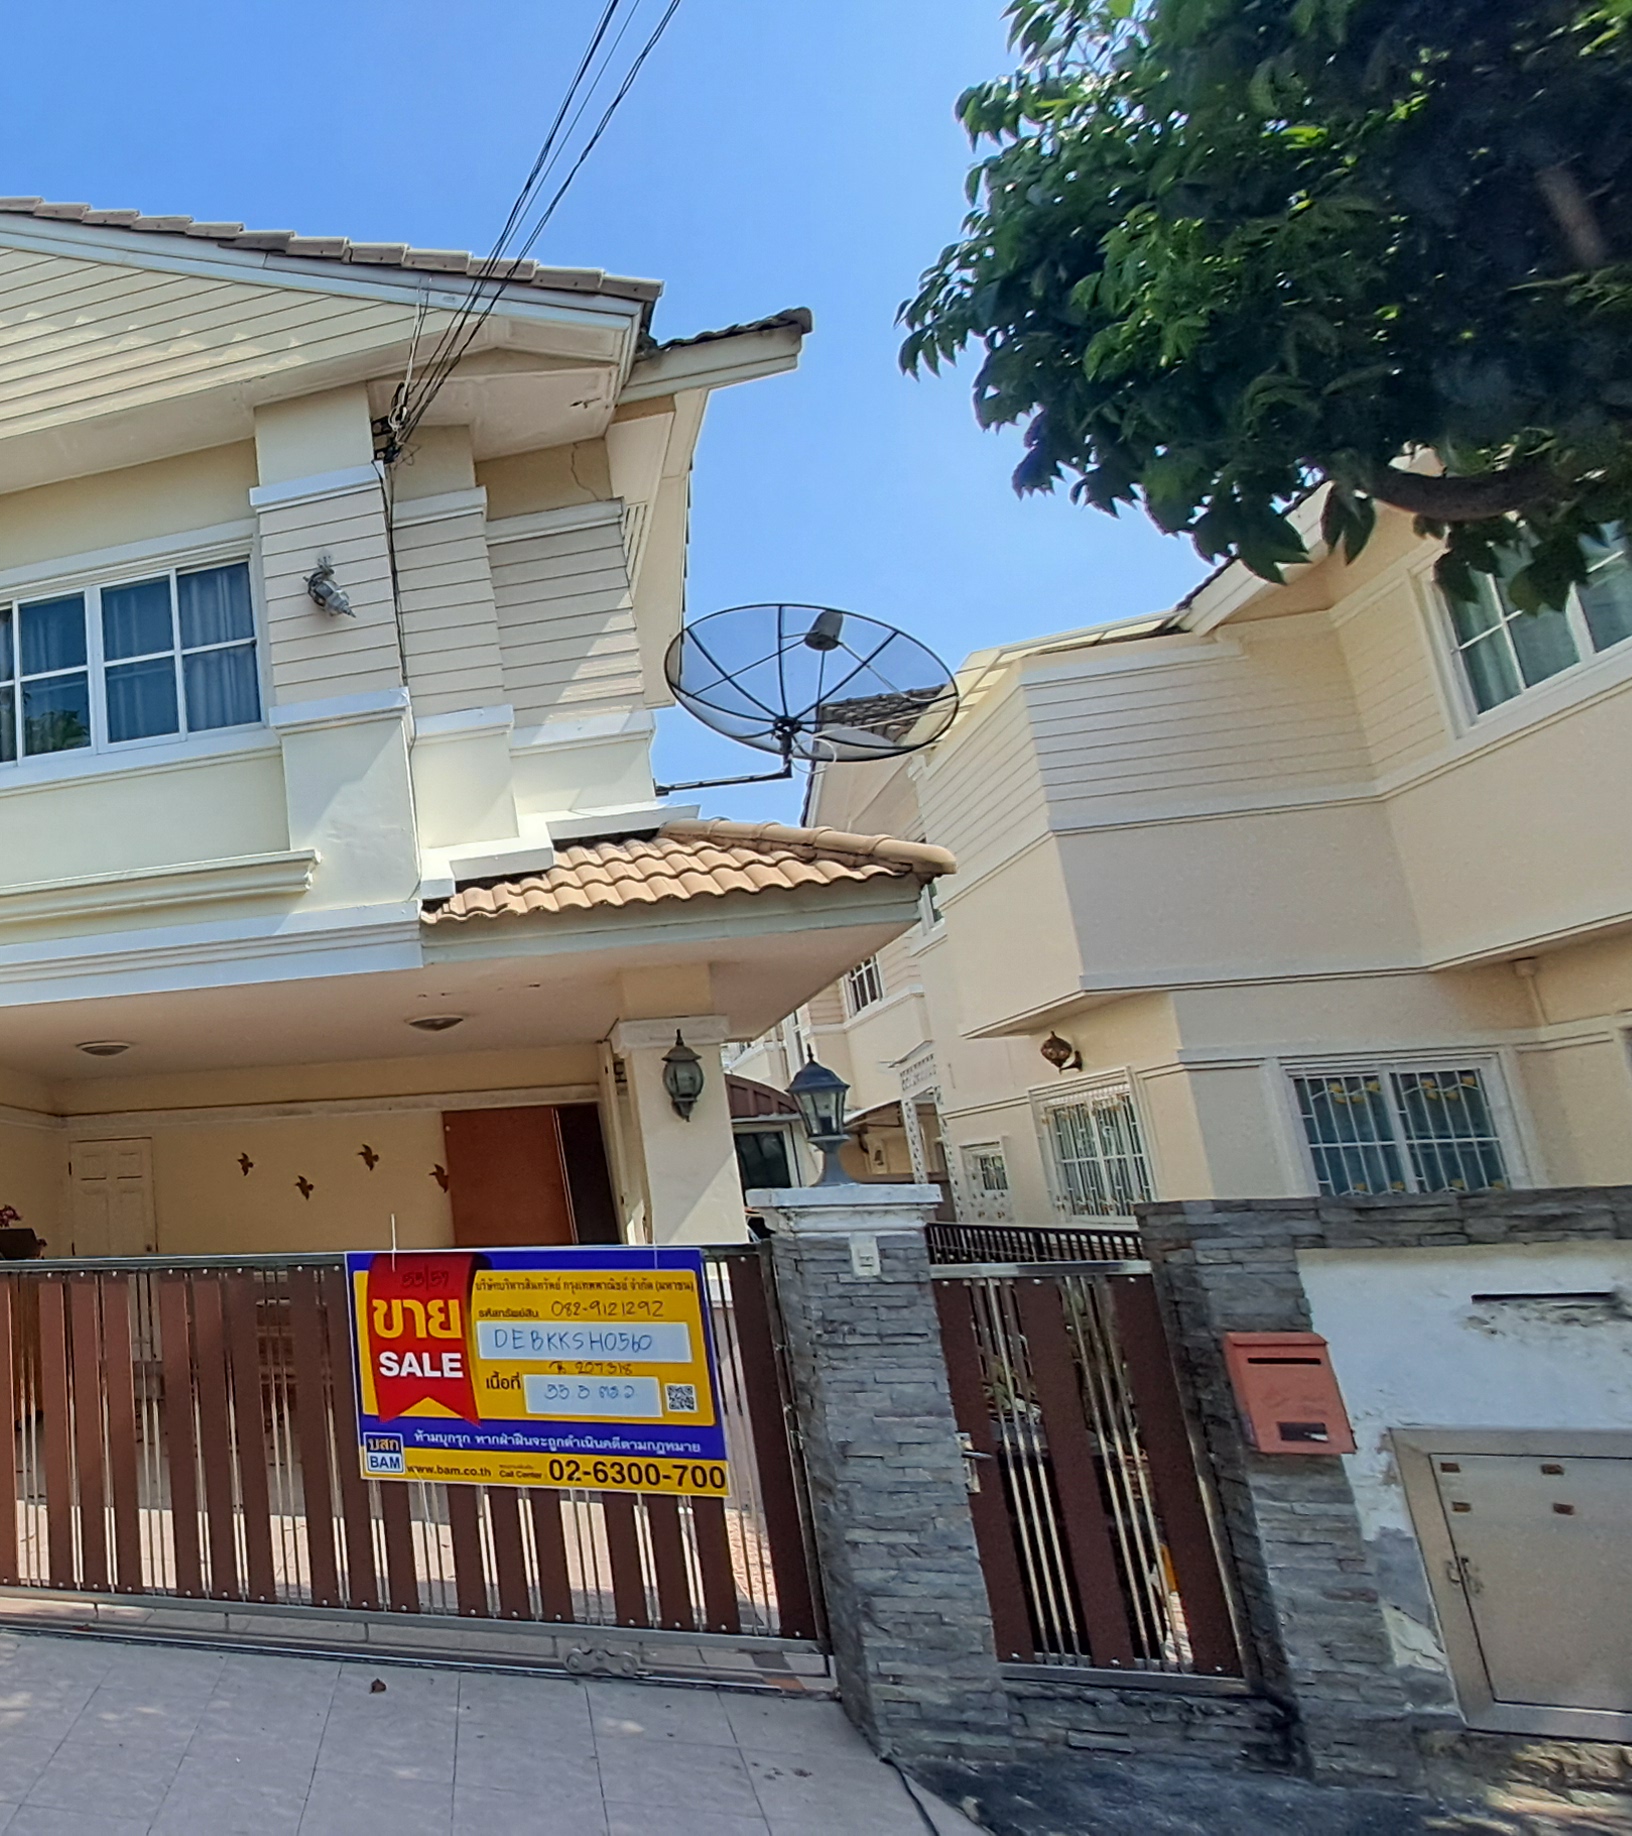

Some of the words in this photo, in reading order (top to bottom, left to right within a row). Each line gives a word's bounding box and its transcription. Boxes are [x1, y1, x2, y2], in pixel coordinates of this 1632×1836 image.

[372, 1299, 462, 1338] ขาย
[379, 1351, 464, 1378] SALE
[486, 1371, 522, 1390] เนื้อที่
[368, 1438, 400, 1451] บสก
[414, 1429, 471, 1448] ห้ามบุกรุก
[370, 1456, 400, 1469] BAM
[407, 1464, 491, 1477] www.bam.co.th
[549, 1459, 726, 1489] 02-6300-700
